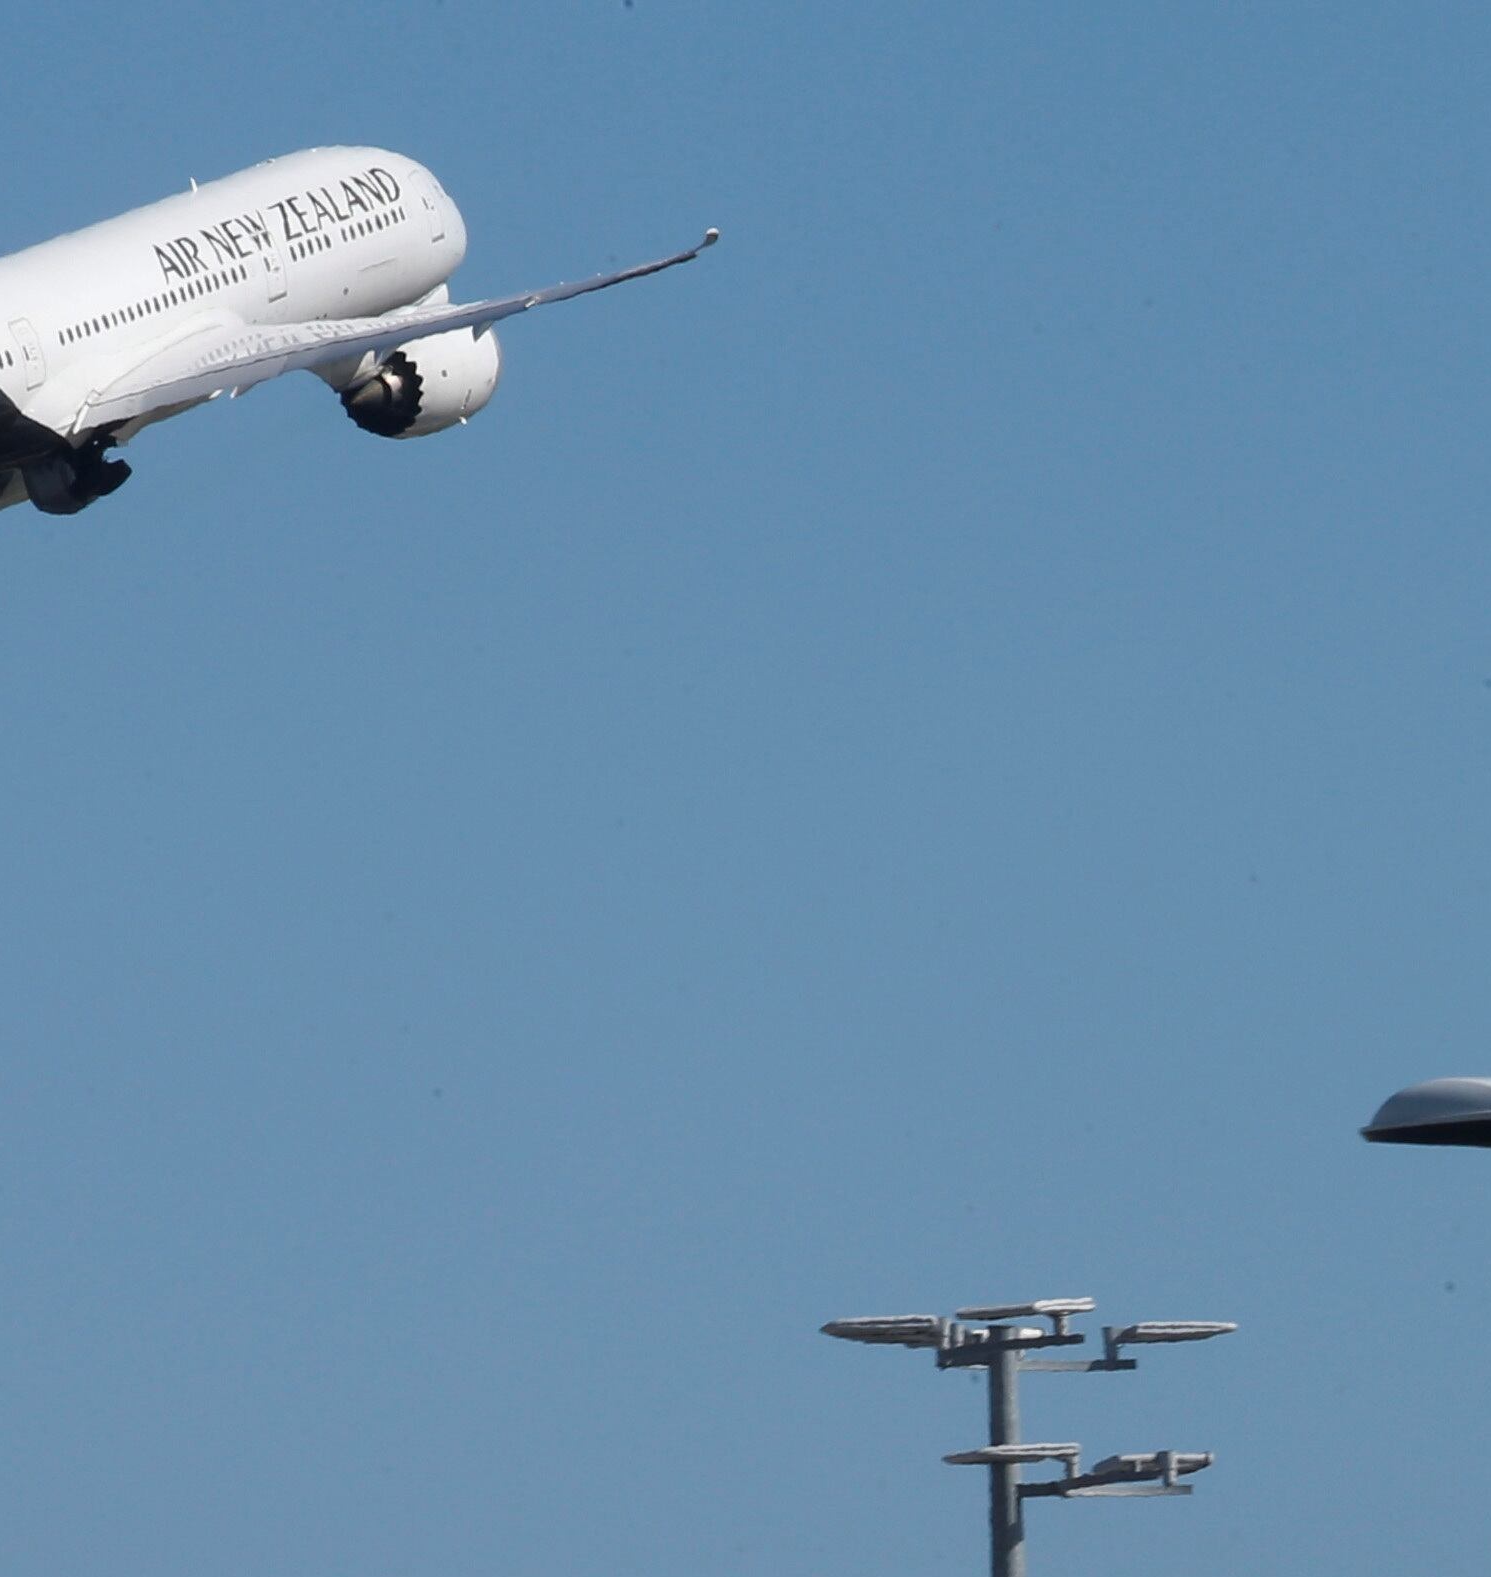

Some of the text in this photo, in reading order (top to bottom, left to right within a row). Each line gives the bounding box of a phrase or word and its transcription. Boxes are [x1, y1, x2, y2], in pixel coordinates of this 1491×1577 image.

[153, 168, 401, 284] AIR NEW ZEALAND
